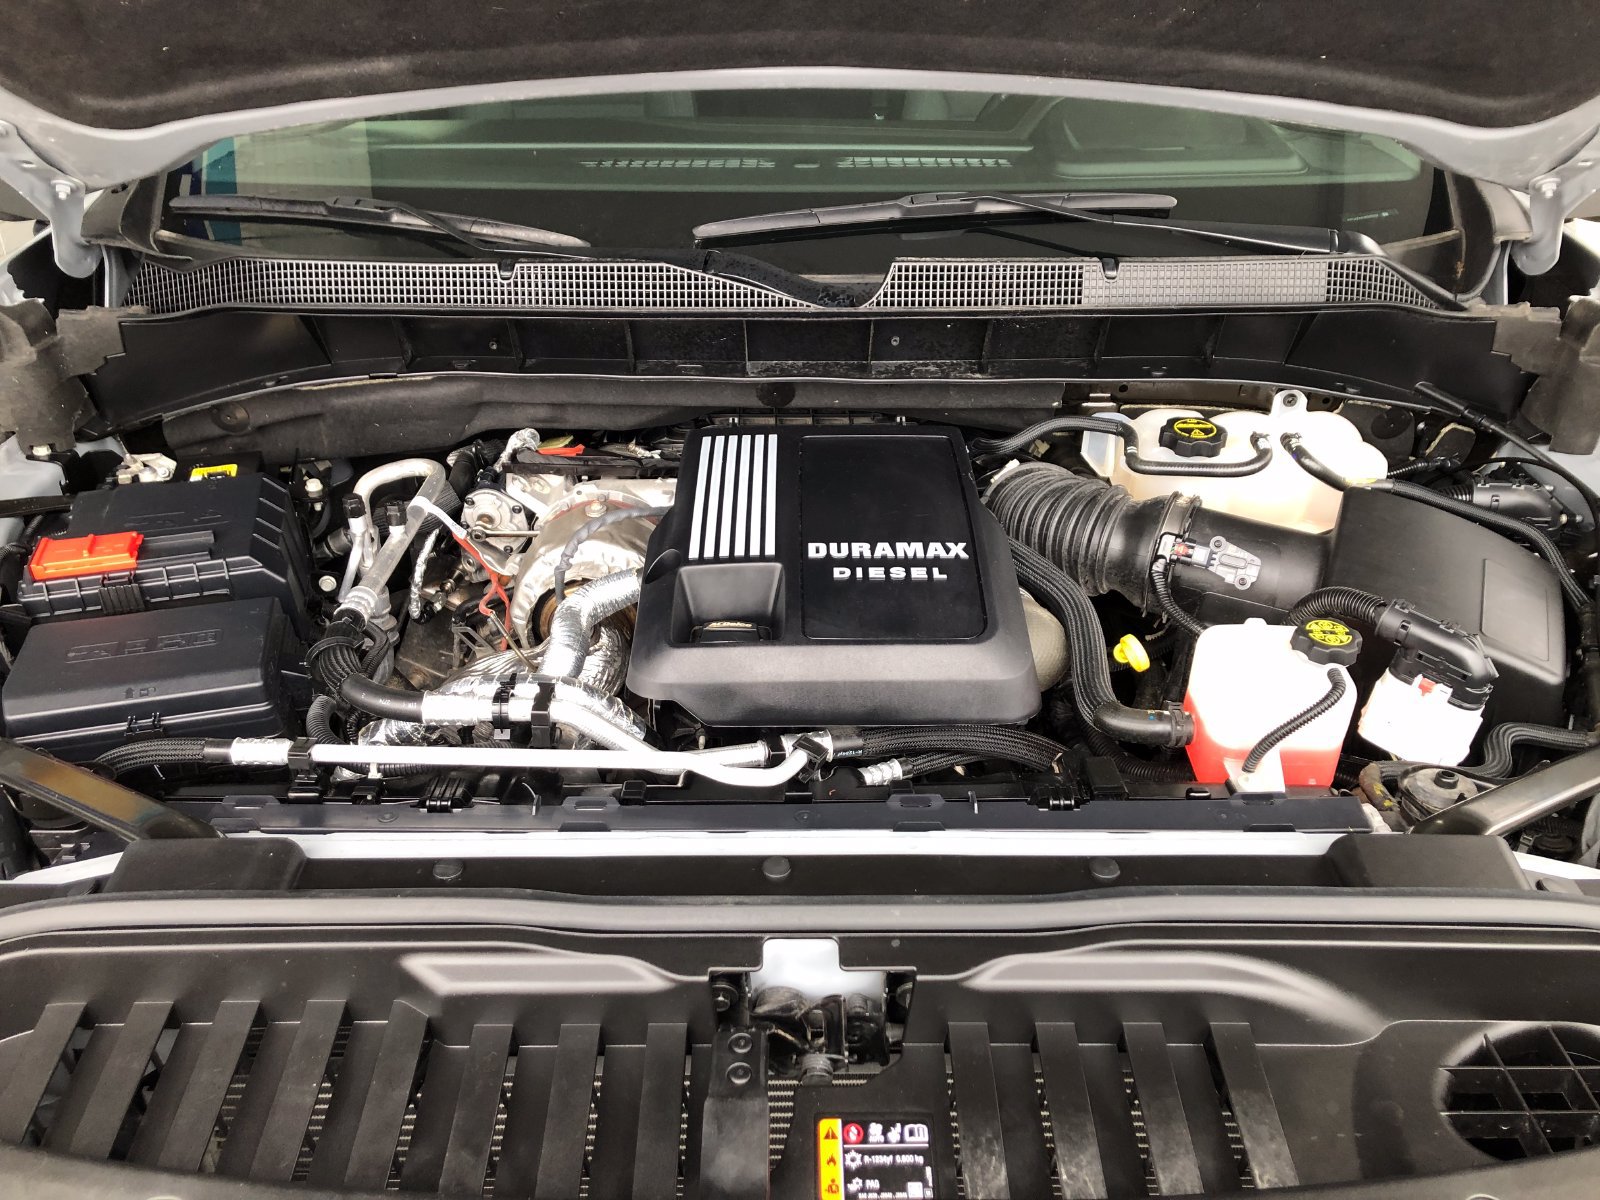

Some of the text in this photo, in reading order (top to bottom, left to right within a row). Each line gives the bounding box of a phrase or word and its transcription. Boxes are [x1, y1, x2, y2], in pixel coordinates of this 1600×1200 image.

[807, 542, 969, 559] DURAMAX
[833, 567, 947, 580] DIESEL
[863, 1154, 893, 1165] R-1234yf
